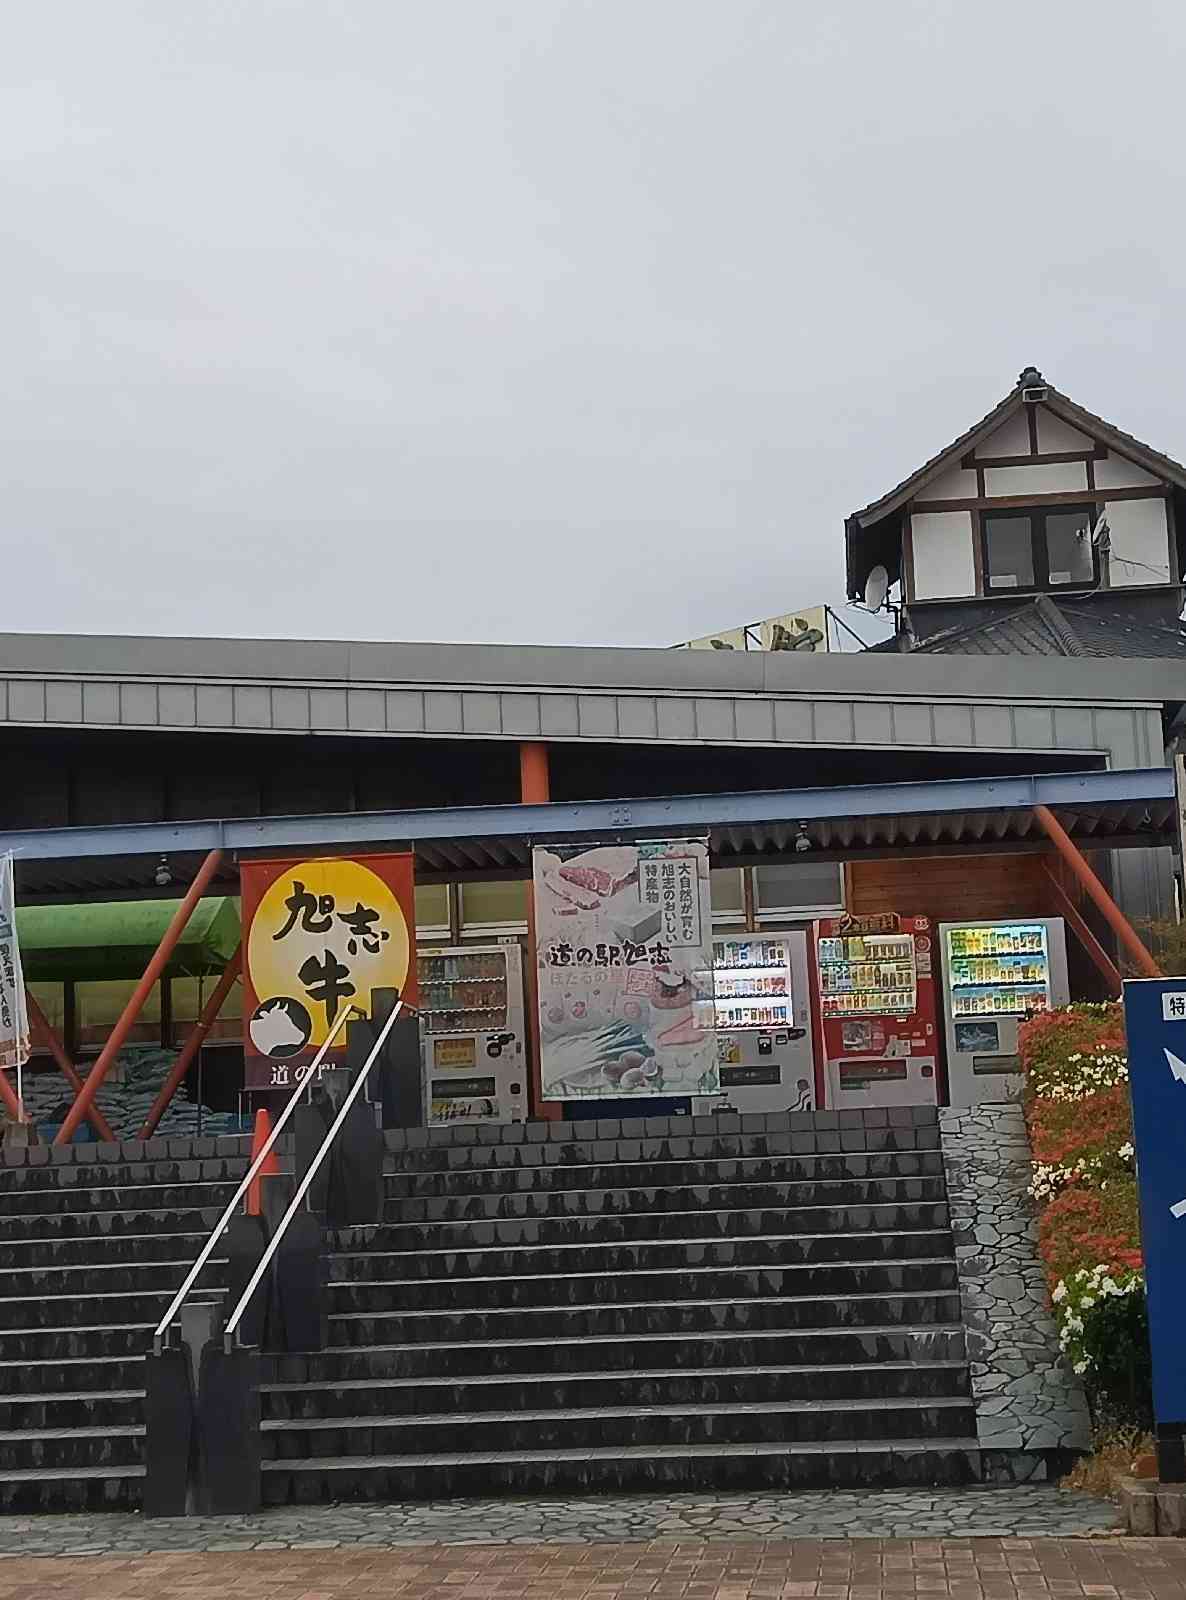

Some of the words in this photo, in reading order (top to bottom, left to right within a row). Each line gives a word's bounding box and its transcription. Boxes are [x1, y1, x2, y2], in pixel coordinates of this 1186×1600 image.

[272, 880, 389, 955] 旭志
[645, 864, 659, 904] 特産物
[661, 863, 678, 943] 旭志のおいしい
[677, 862, 694, 941] 大自然が育む
[297, 948, 356, 1030] 牛
[550, 940, 672, 966] 道の駅旭志
[1169, 997, 1185, 1015] 特
